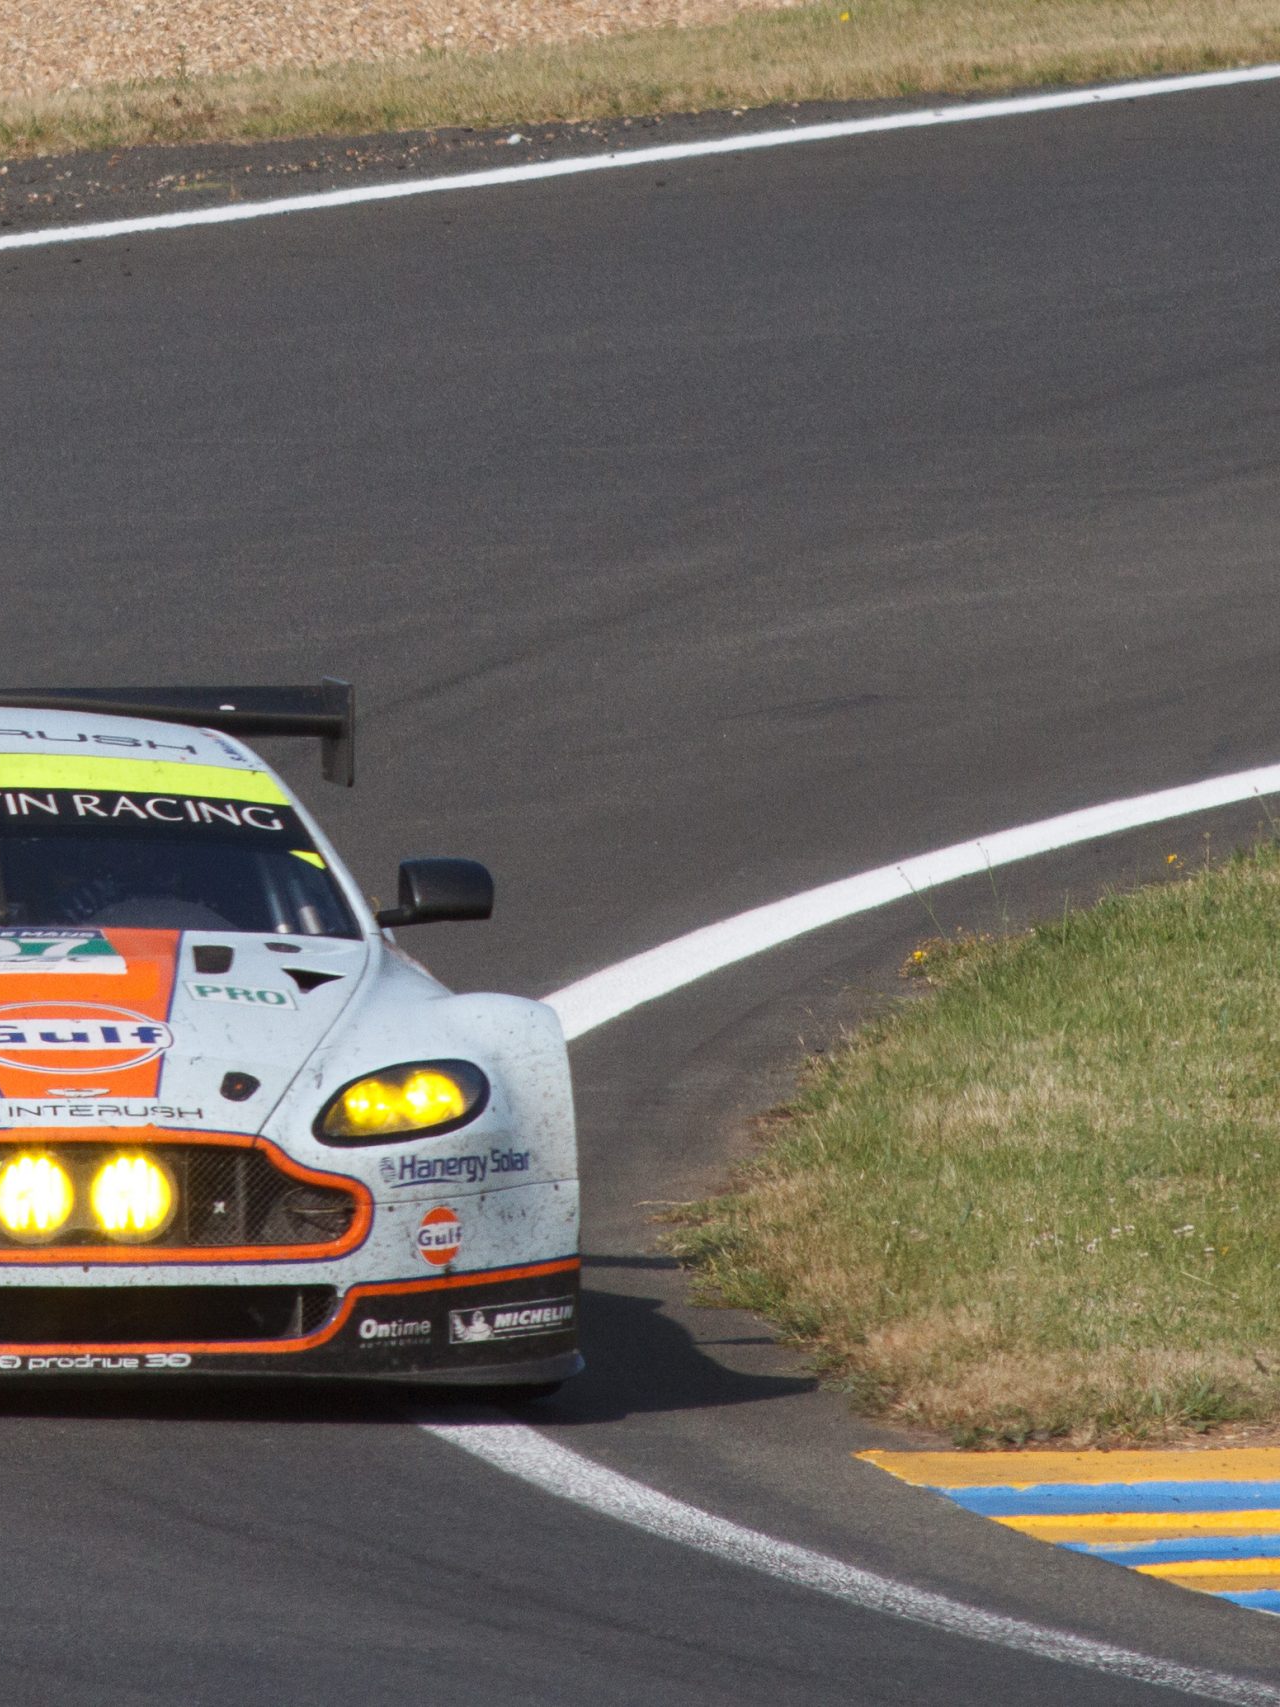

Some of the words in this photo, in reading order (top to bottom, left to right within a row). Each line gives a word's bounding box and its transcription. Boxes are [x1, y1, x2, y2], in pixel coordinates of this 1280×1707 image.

[72, 794, 283, 830] RACING
[195, 985, 287, 1005] PRO
[8, 1105, 204, 1119] INTERUSH
[398, 1154, 488, 1183] Hanergy
[490, 1149, 531, 1173] Solar
[418, 1227, 463, 1246] Gulf
[494, 1305, 574, 1329] MICHELIN
[360, 1319, 432, 1339] Ontime
[28, 1354, 139, 1370] prodrive
